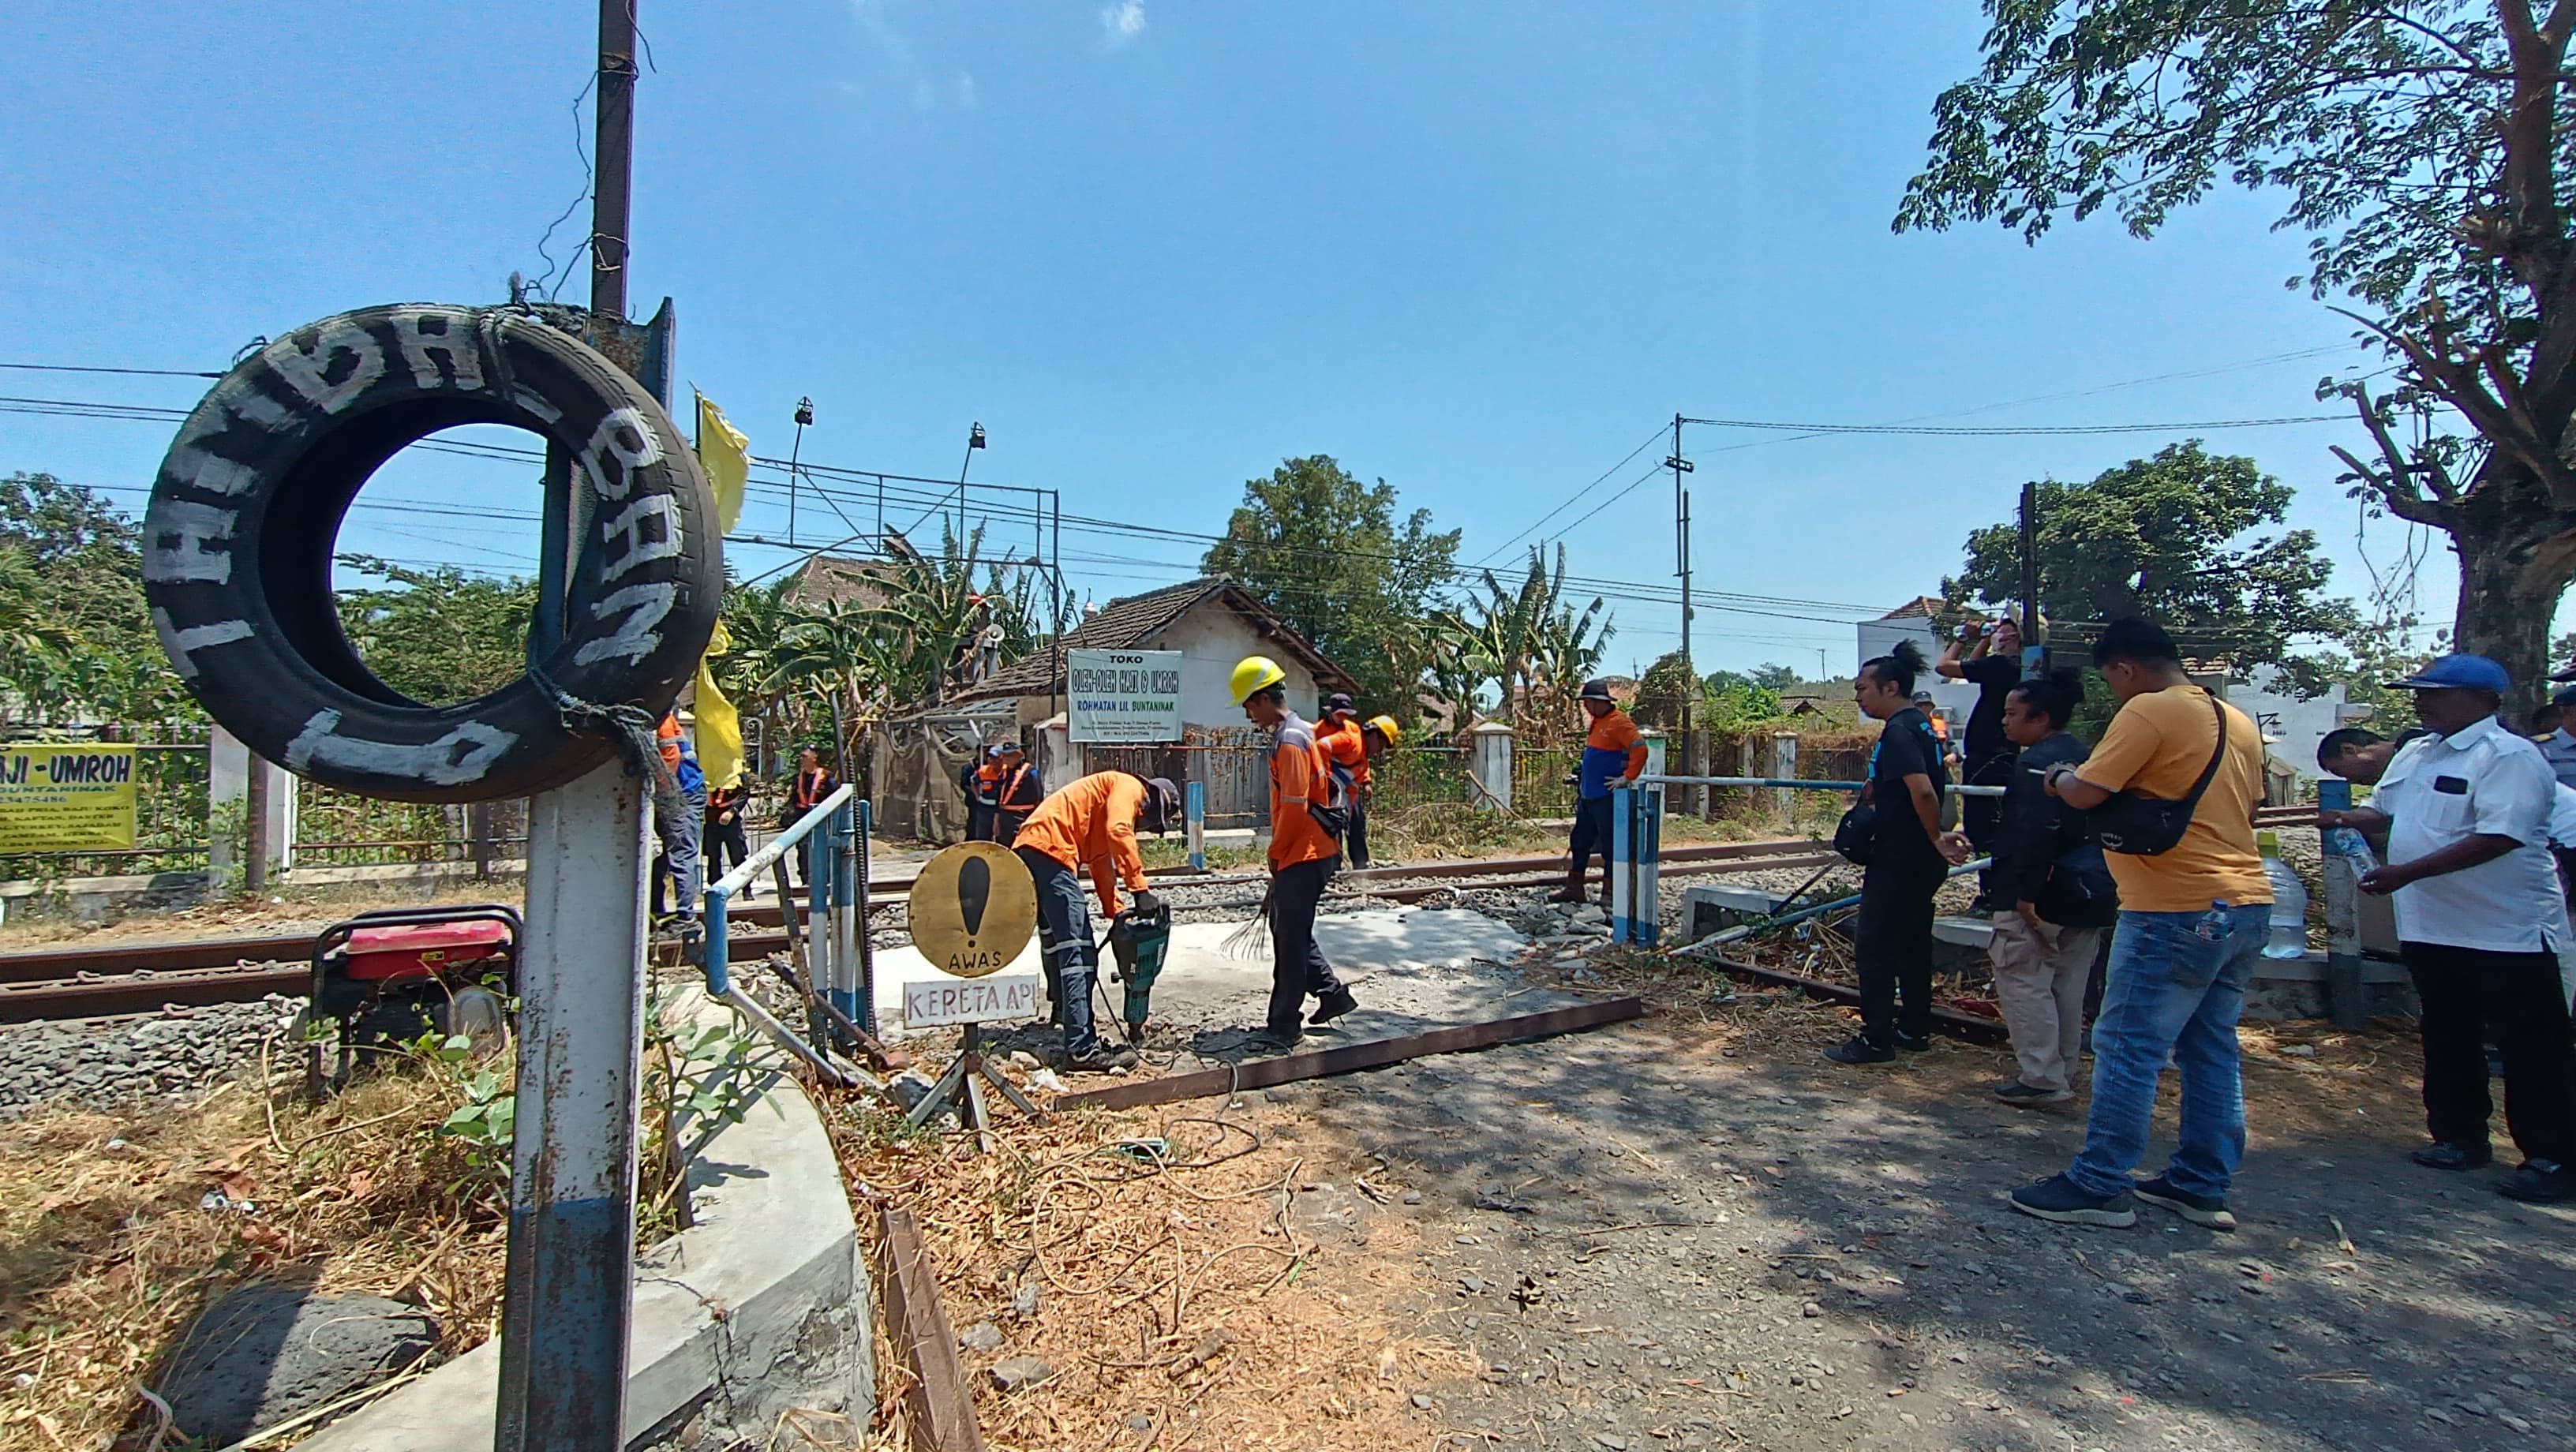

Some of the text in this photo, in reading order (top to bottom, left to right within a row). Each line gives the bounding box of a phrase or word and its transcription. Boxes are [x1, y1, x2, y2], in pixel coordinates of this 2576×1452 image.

[574, 406, 684, 668] BAN
[1110, 655, 1144, 664] TOKO
[1073, 668, 1117, 693] OLEH-OLEH
[1119, 669, 1139, 694] HAJI
[1151, 670, 1178, 694] UMROH
[1077, 700, 1174, 712] ROHMATAN LIL BUNTANINAK
[949, 950, 1002, 971] AWAS
[908, 982, 1037, 1020] KERETA API
